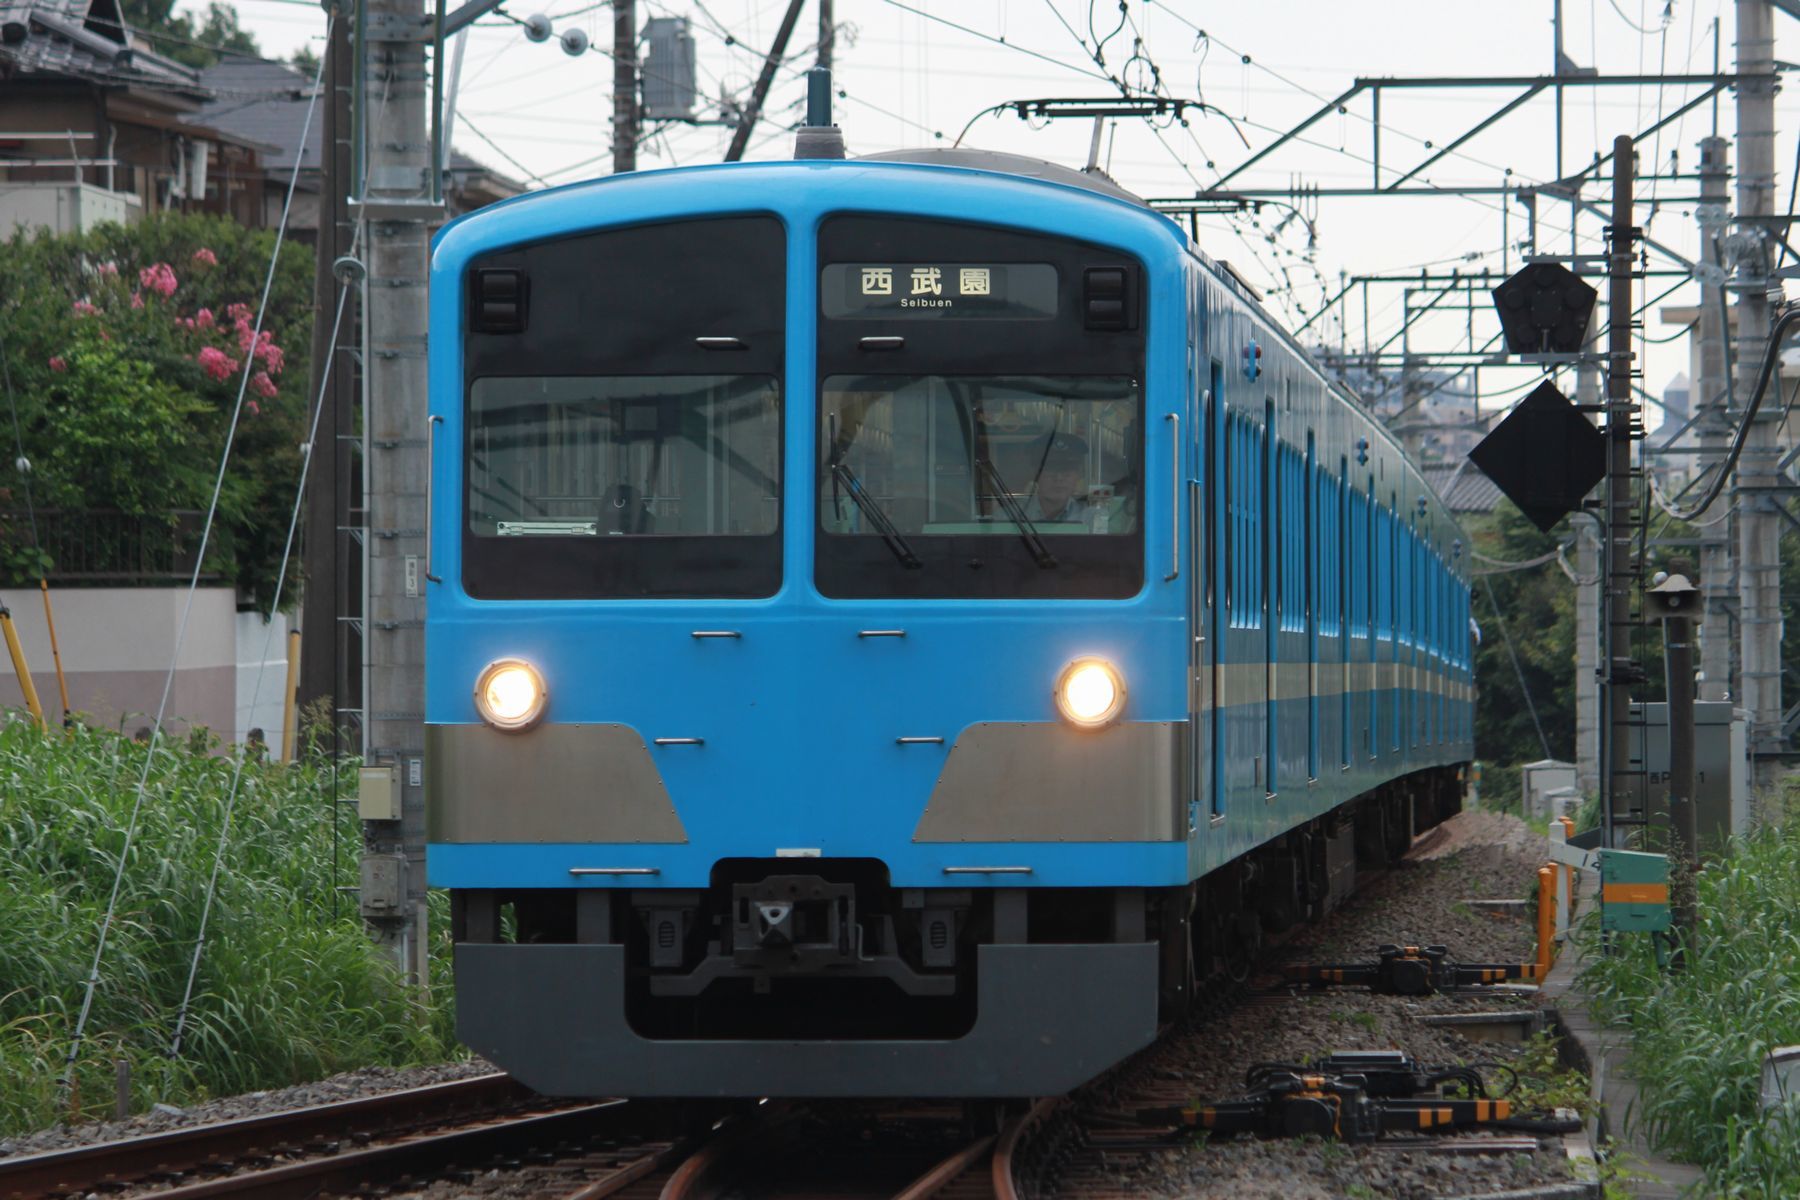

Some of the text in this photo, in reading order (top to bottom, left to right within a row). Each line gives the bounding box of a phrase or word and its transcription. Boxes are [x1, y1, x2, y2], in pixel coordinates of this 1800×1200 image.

[861, 267, 990, 295] 西武園
[900, 298, 952, 307] Seibuen
